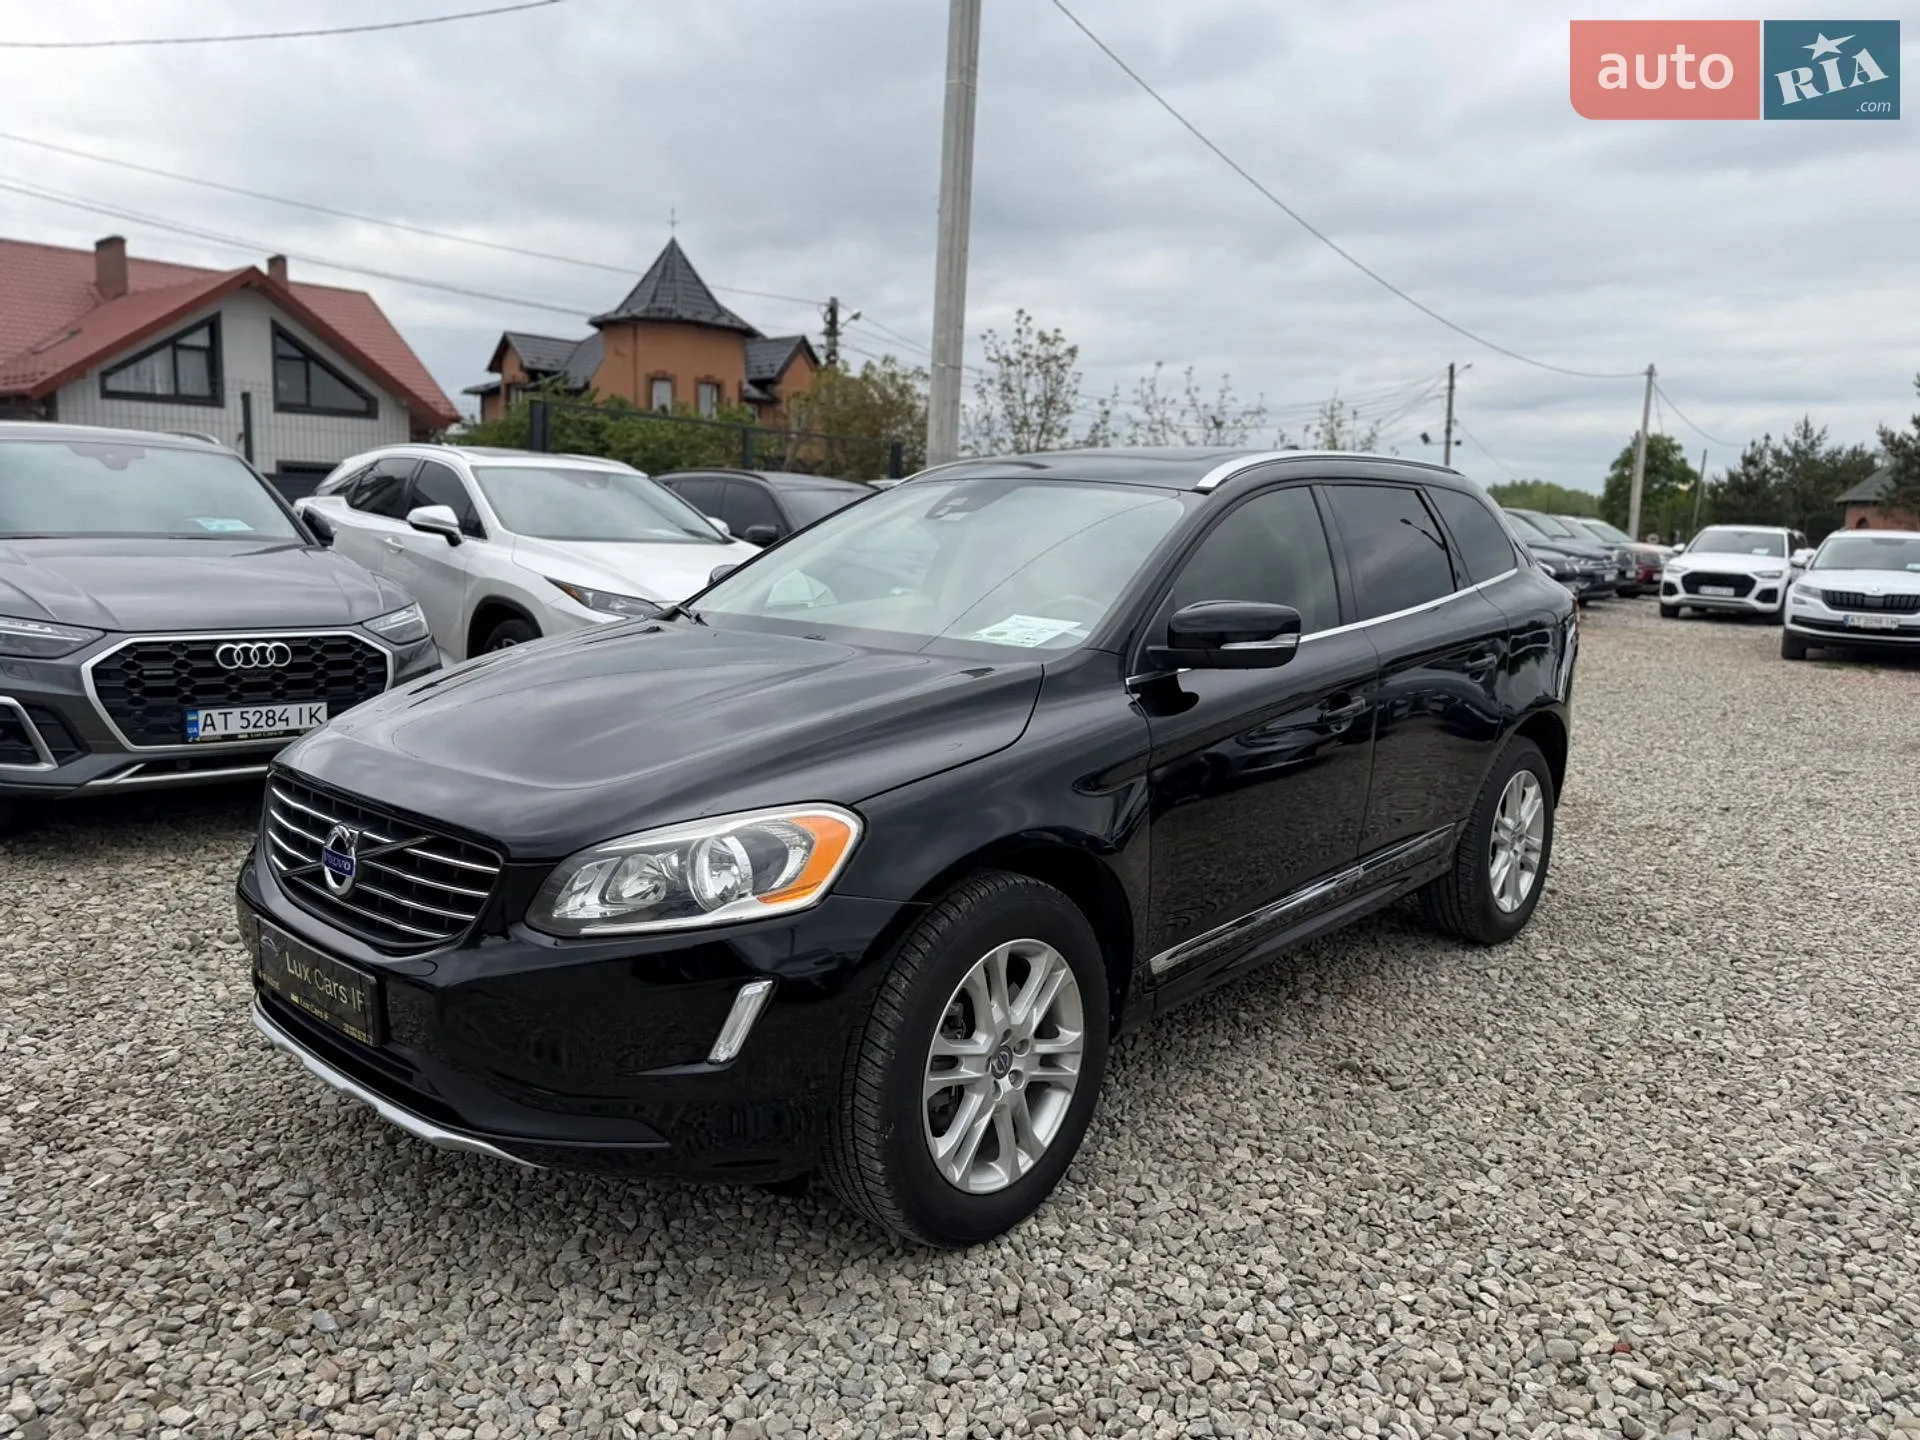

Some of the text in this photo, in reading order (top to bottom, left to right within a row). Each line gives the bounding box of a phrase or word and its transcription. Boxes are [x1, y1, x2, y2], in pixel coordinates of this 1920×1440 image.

[201, 706, 323, 731] AT 5284 IK
[285, 951, 312, 985] Lux
[314, 968, 348, 1004] Cars
[351, 987, 365, 1012] IF
